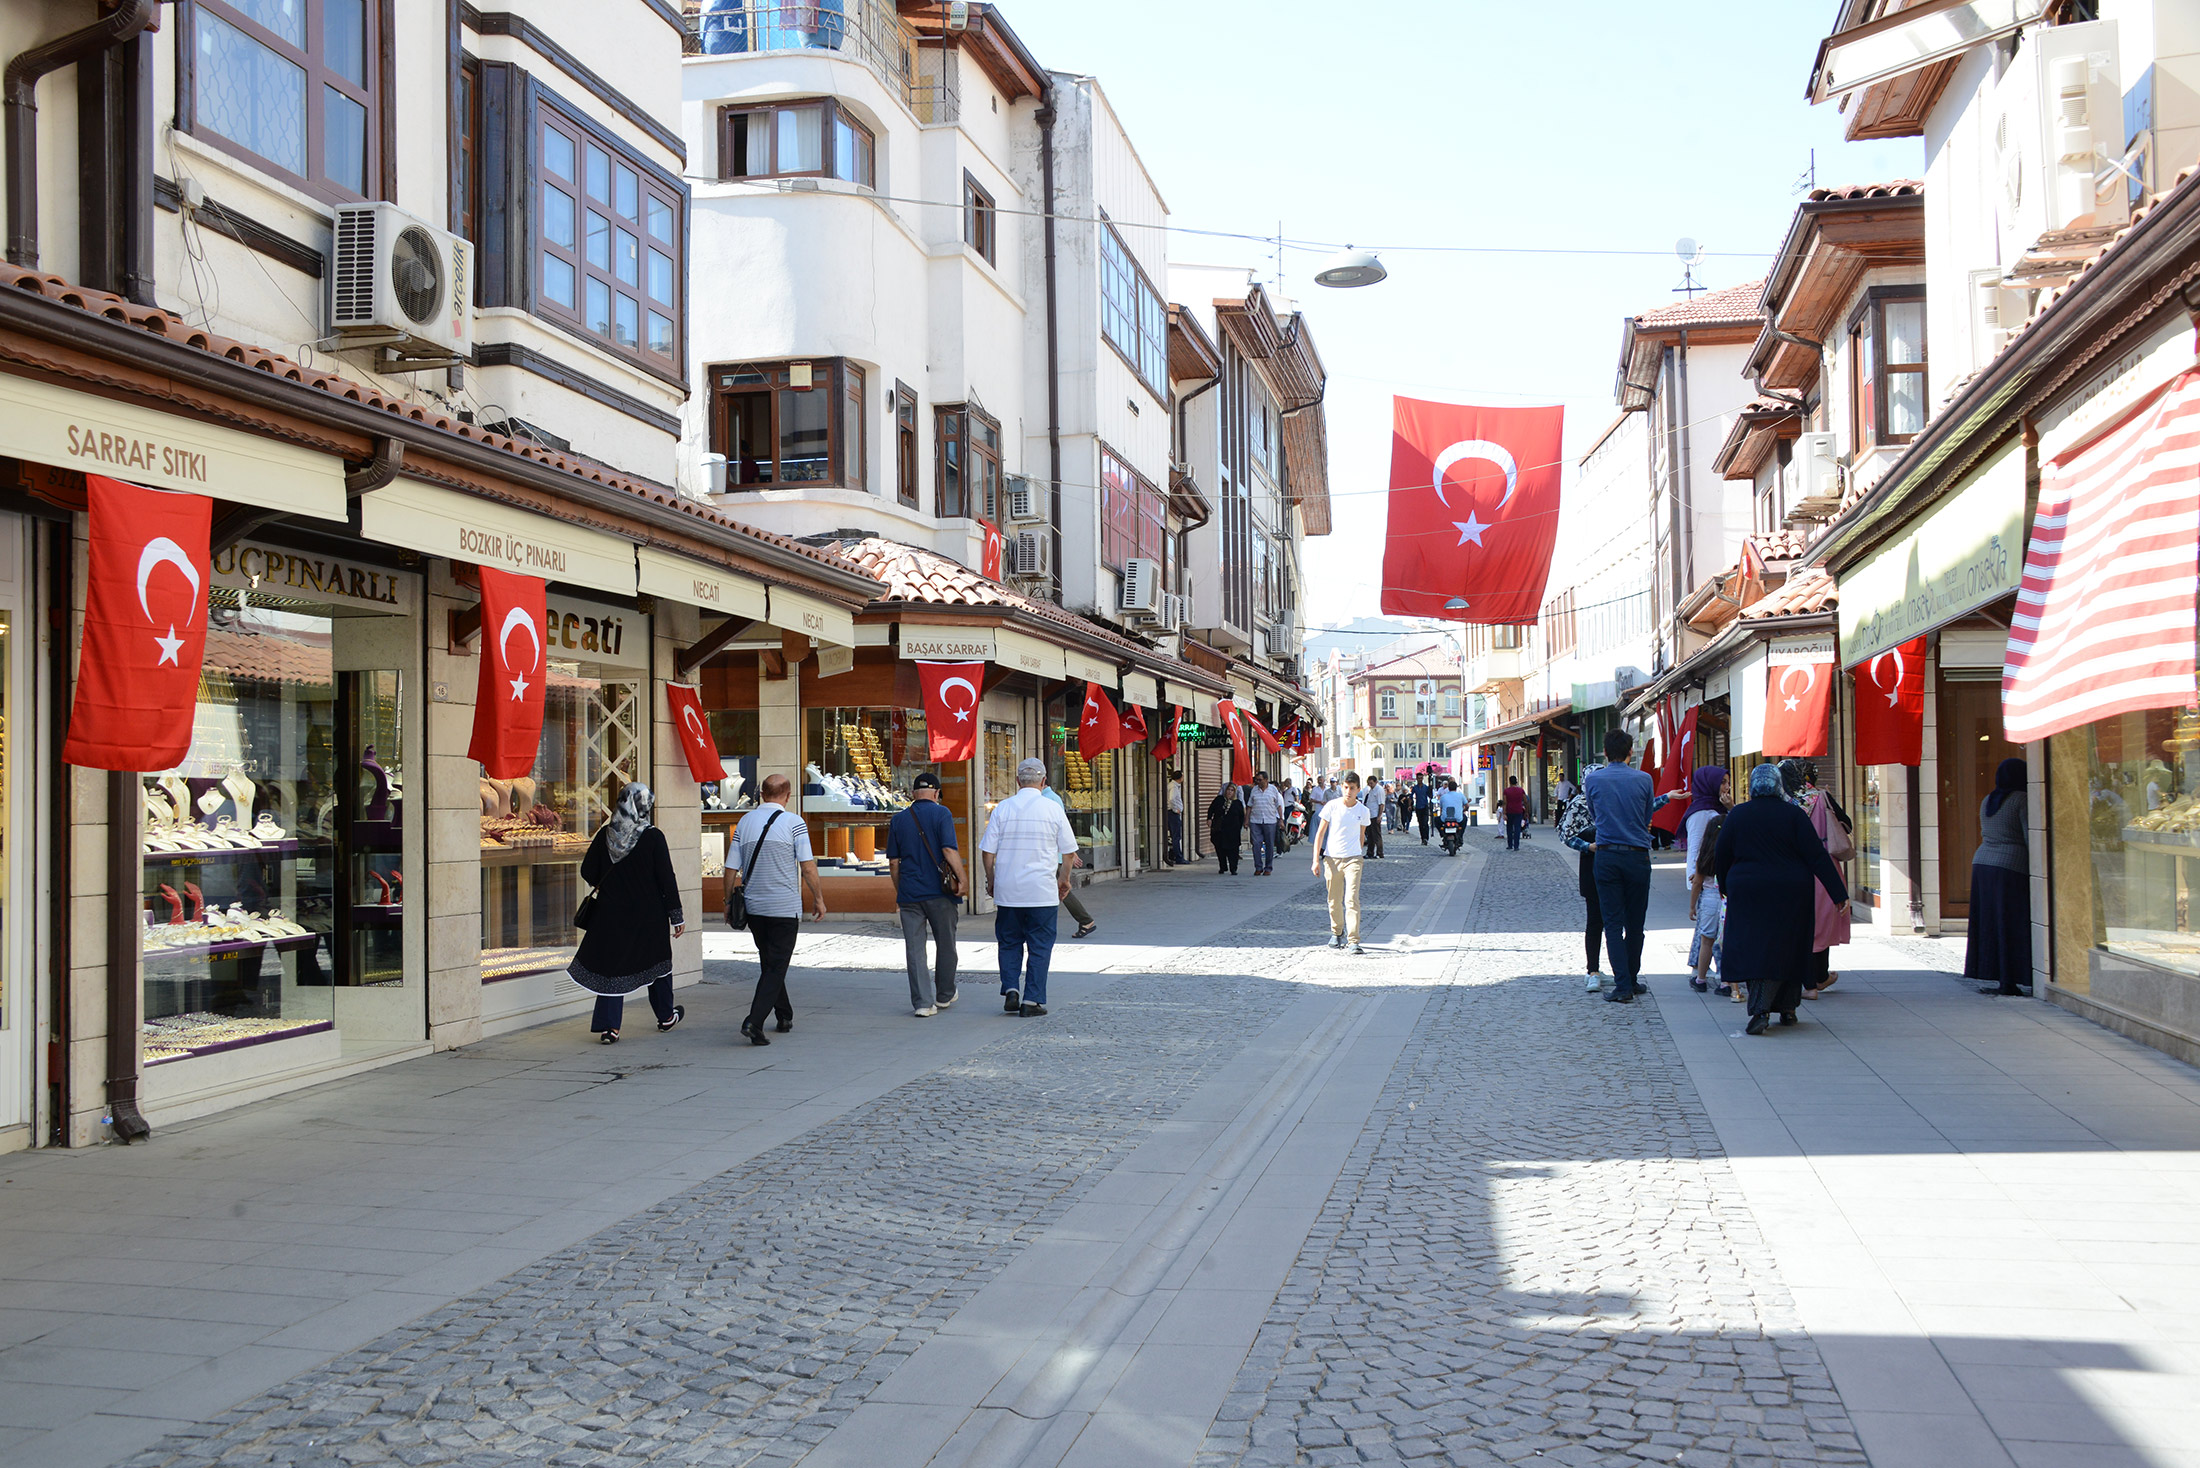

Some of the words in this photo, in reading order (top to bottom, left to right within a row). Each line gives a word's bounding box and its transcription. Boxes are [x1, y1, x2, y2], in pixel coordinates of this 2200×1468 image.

[453, 242, 465, 316] arçelik
[67, 424, 156, 471] SARRAF
[163, 446, 207, 482] SITKI
[460, 527, 502, 559] BOZKIR
[506, 534, 523, 567] ÜÇ
[526, 544, 566, 573] PINARLI
[693, 579, 720, 603] NECATİ
[546, 608, 623, 656] ecati
[802, 612, 824, 632] NECATİ
[907, 642, 943, 656] BAŞAK
[947, 643, 988, 656] SARRAF
[1770, 643, 1832, 661] UYAROĞLU
